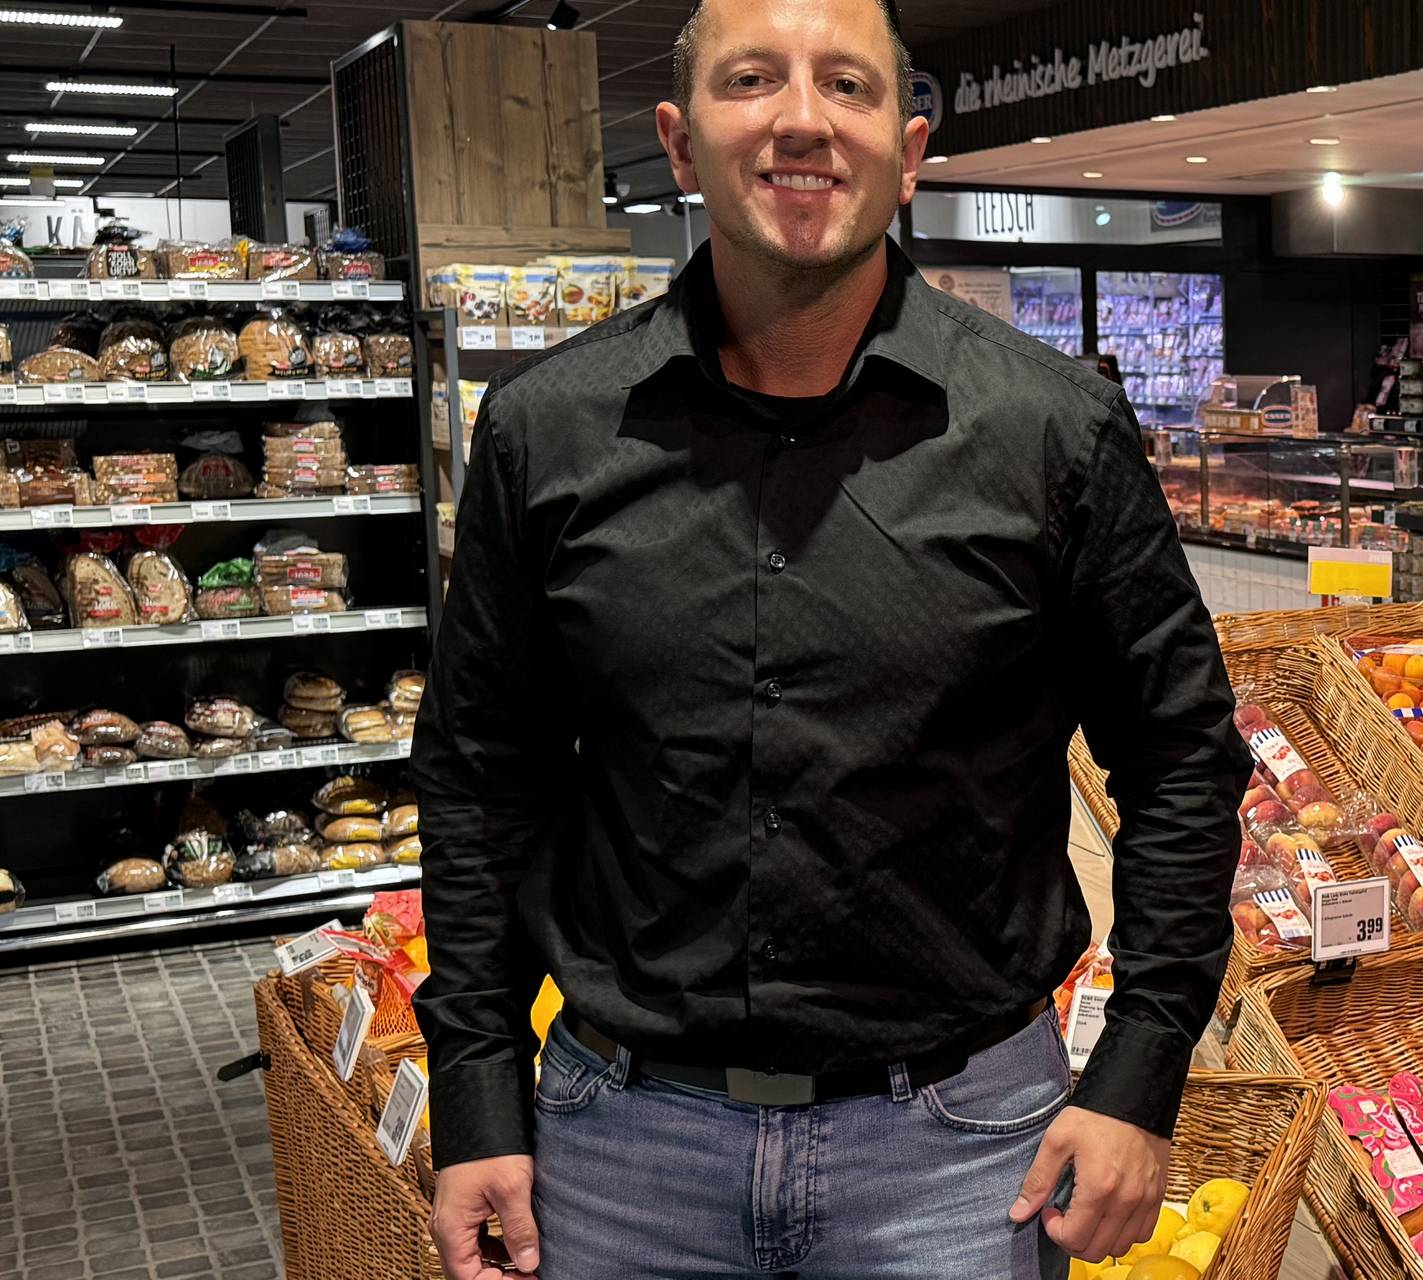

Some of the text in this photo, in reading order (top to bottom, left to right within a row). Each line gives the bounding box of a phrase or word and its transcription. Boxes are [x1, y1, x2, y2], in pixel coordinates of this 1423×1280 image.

[954, 71, 981, 114] die
[984, 48, 1083, 106] rheinische
[975, 192, 1035, 236] FLEISCH
[1356, 917, 1383, 942] 3.99
